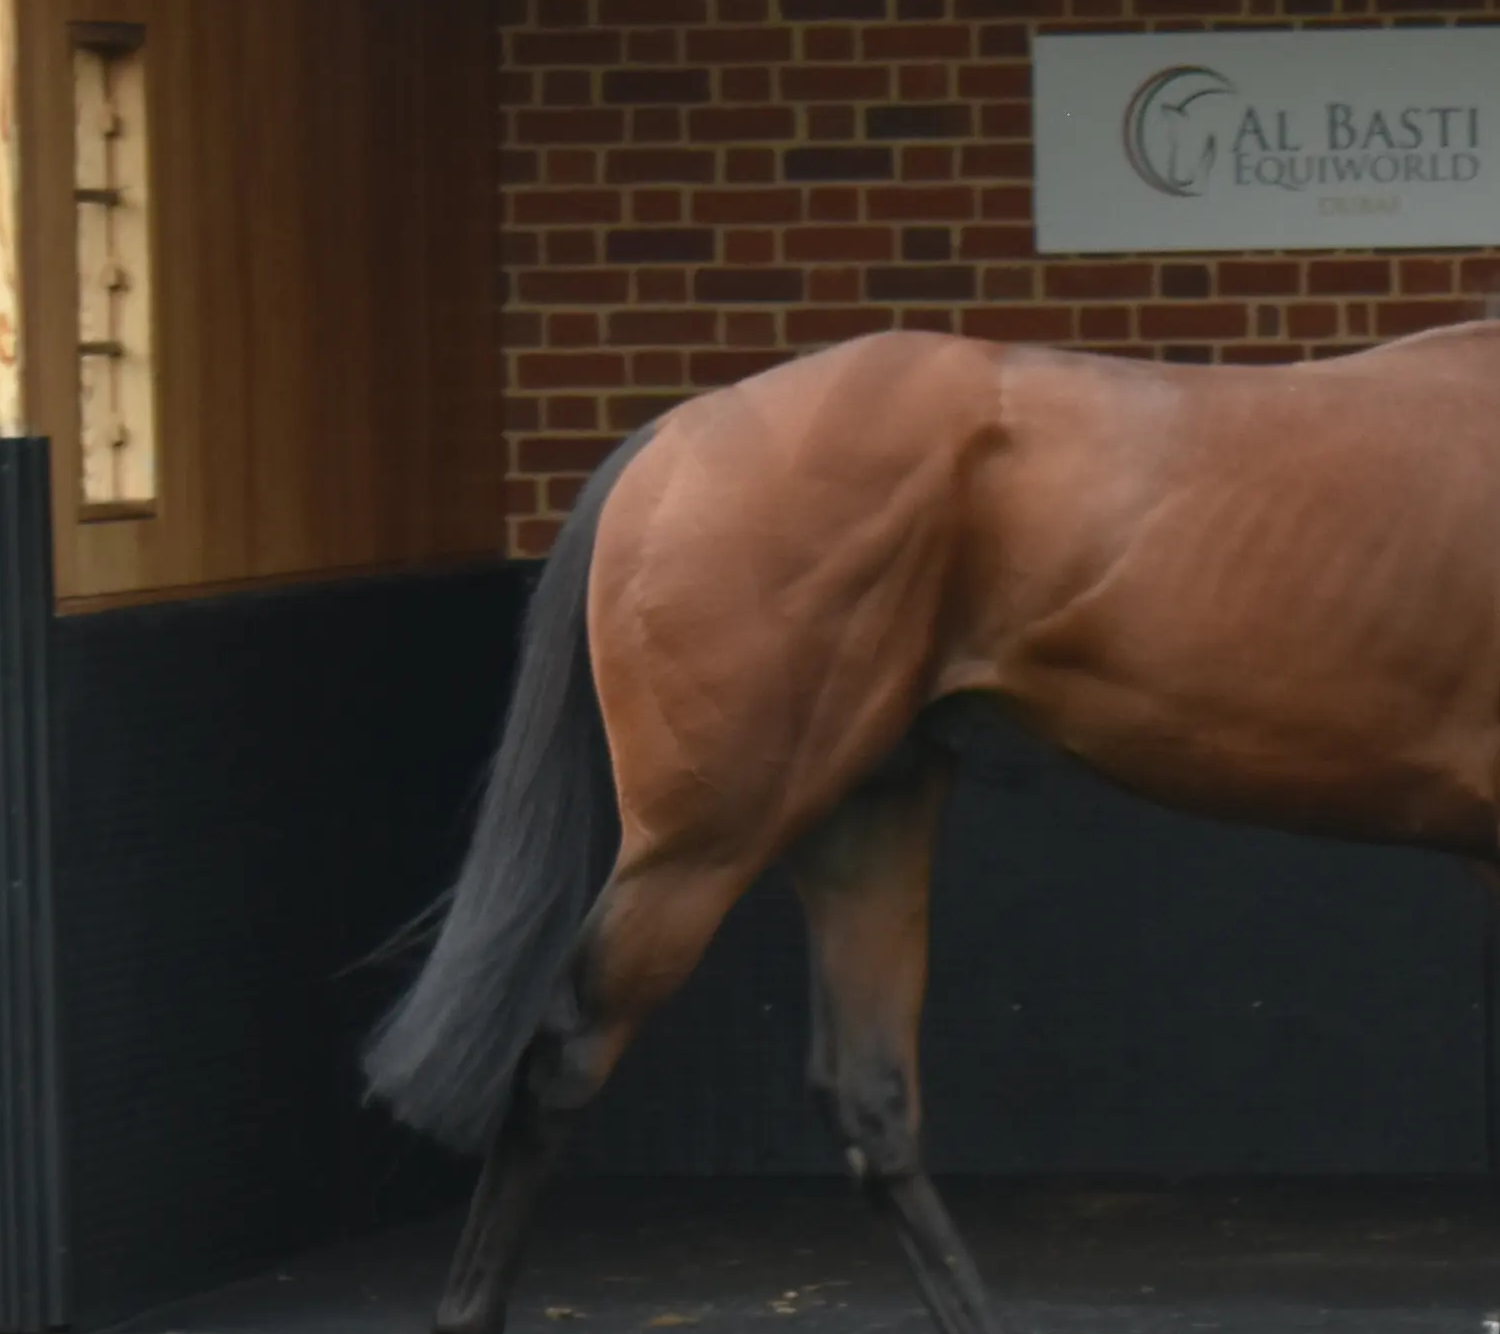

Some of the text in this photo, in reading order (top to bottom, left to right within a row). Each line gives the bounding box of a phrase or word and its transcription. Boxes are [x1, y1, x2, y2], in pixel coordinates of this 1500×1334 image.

[1232, 103, 1478, 151] AL BASTI
[1235, 152, 1481, 191] EQUIWORLD
